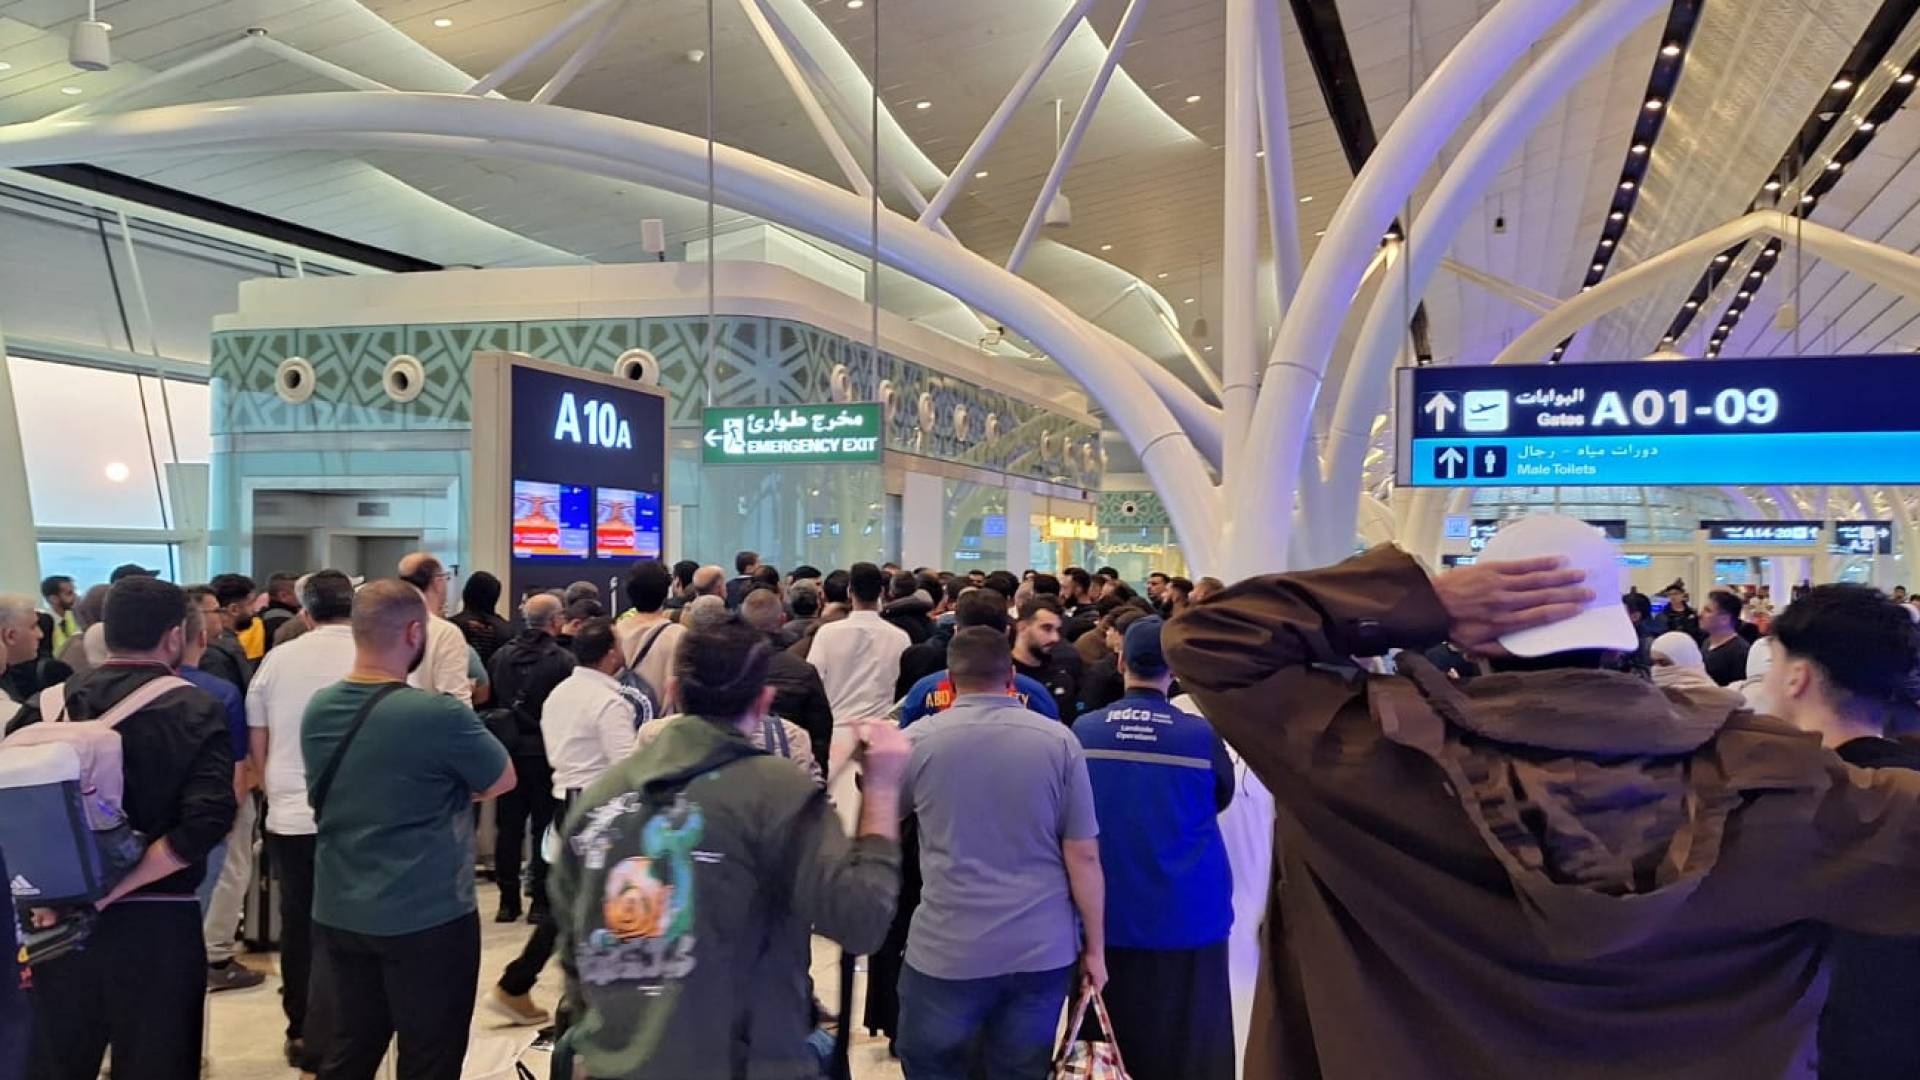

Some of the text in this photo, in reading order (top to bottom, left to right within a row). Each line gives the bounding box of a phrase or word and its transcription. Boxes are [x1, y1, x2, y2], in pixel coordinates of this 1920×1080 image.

[1515, 387, 1585, 407] البوابات
[1591, 387, 1779, 427] A01-09
[746, 408, 864, 434] مخرج طوارئ
[1536, 412, 1585, 427] Gates
[747, 436, 878, 454] EMERGENCY EXIT
[1518, 445, 1556, 459] رجال
[1577, 444, 1605, 458] مياه
[1610, 443, 1659, 459] دورات
[1517, 463, 1597, 475] Male Toilets
[1105, 707, 1151, 723] jedco
